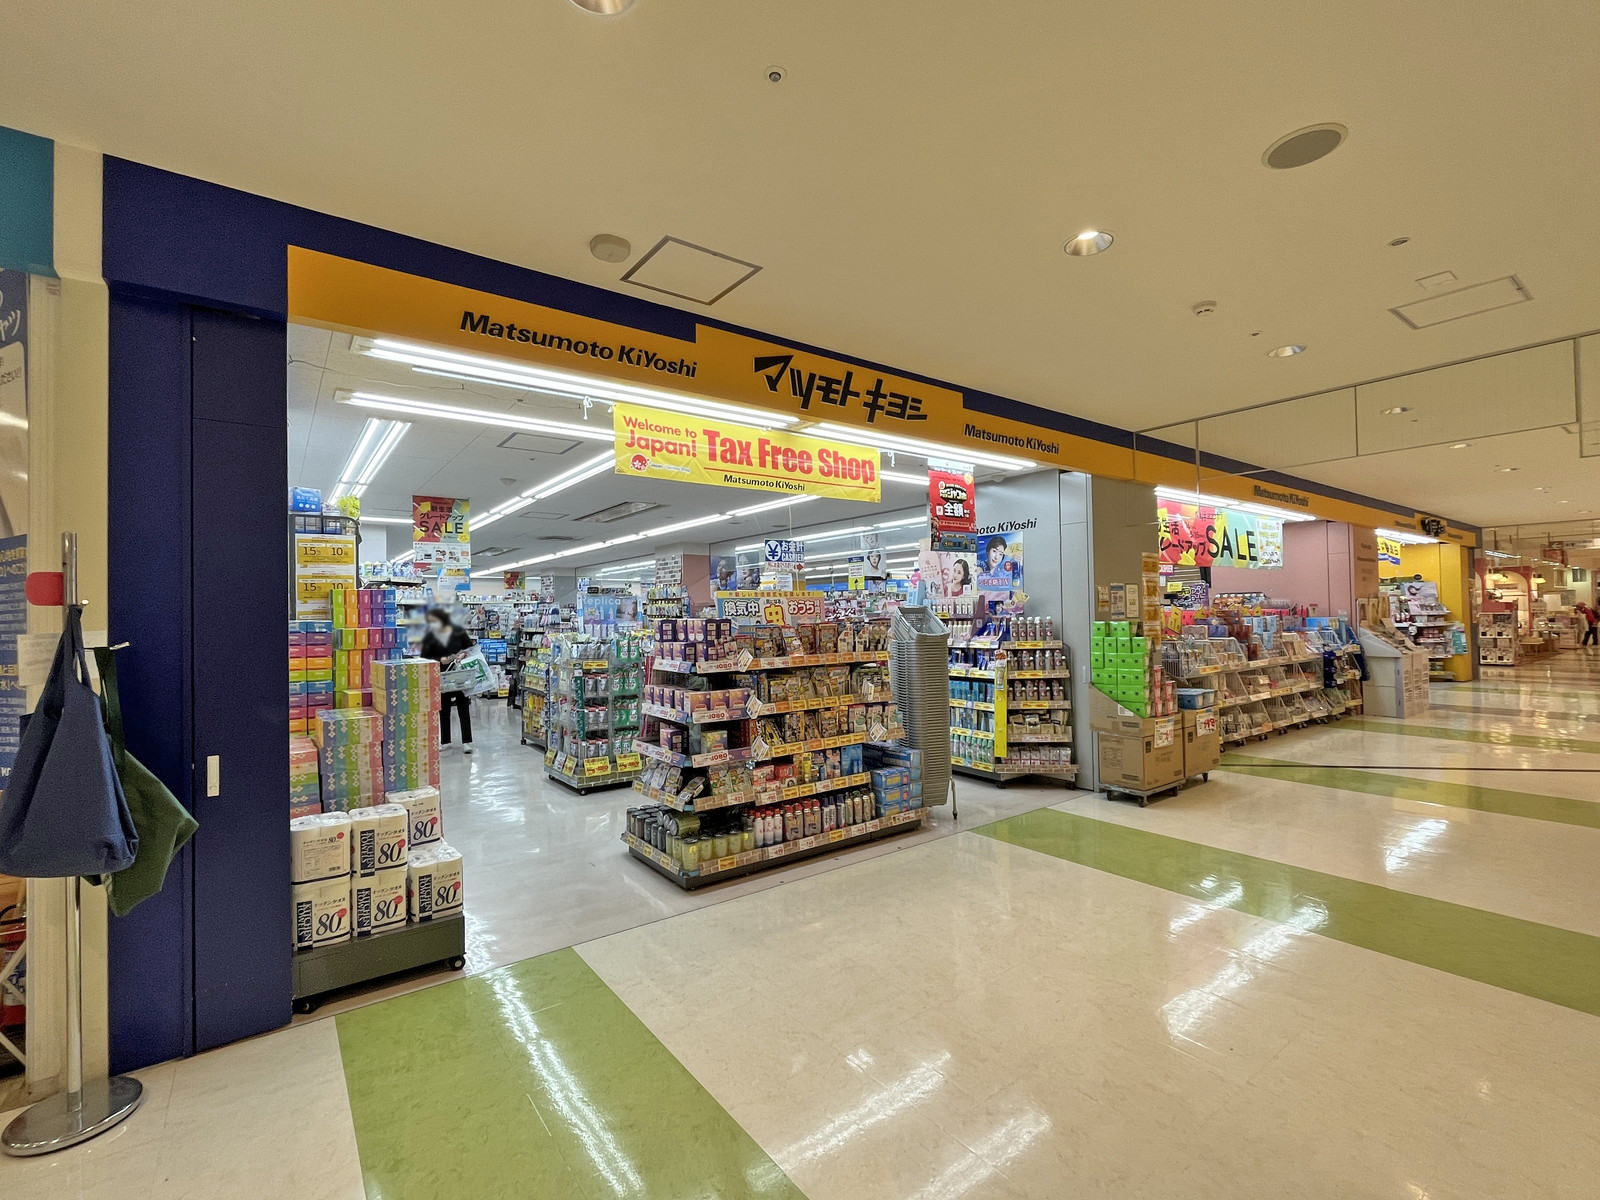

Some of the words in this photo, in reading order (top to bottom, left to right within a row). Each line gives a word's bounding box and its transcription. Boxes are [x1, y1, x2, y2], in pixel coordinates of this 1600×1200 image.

[460, 310, 614, 361] Matsumoto
[617, 345, 698, 378] KiYoshi
[623, 415, 682, 437] Welcome
[685, 428, 698, 439] to
[624, 430, 698, 458] Japan!
[964, 423, 1025, 448] Matsumoto
[1025, 437, 1060, 455] KiYoshi
[702, 429, 754, 468] Tax
[757, 437, 814, 475] Free
[817, 447, 876, 485] Shop
[723, 474, 775, 488] Matsumoto
[775, 479, 806, 492] KiYoshi
[419, 513, 465, 521] グレードアップ
[943, 502, 964, 517] 全額
[419, 520, 464, 535] SALE
[997, 518, 1038, 533] KiYoshi
[303, 546, 317, 556] 15
[331, 547, 344, 556] 10
[781, 540, 805, 552] お会計
[1205, 524, 1258, 562] SALE
[781, 552, 805, 562] CASHIER
[303, 582, 317, 591] 15
[580, 595, 621, 608] Replica
[724, 600, 760, 617] 換気中
[787, 600, 815, 615] おうち
[413, 819, 434, 841] 80
[378, 839, 402, 864] 80
[435, 885, 457, 907] 80
[374, 897, 399, 922] 80
[316, 911, 343, 936] 80
